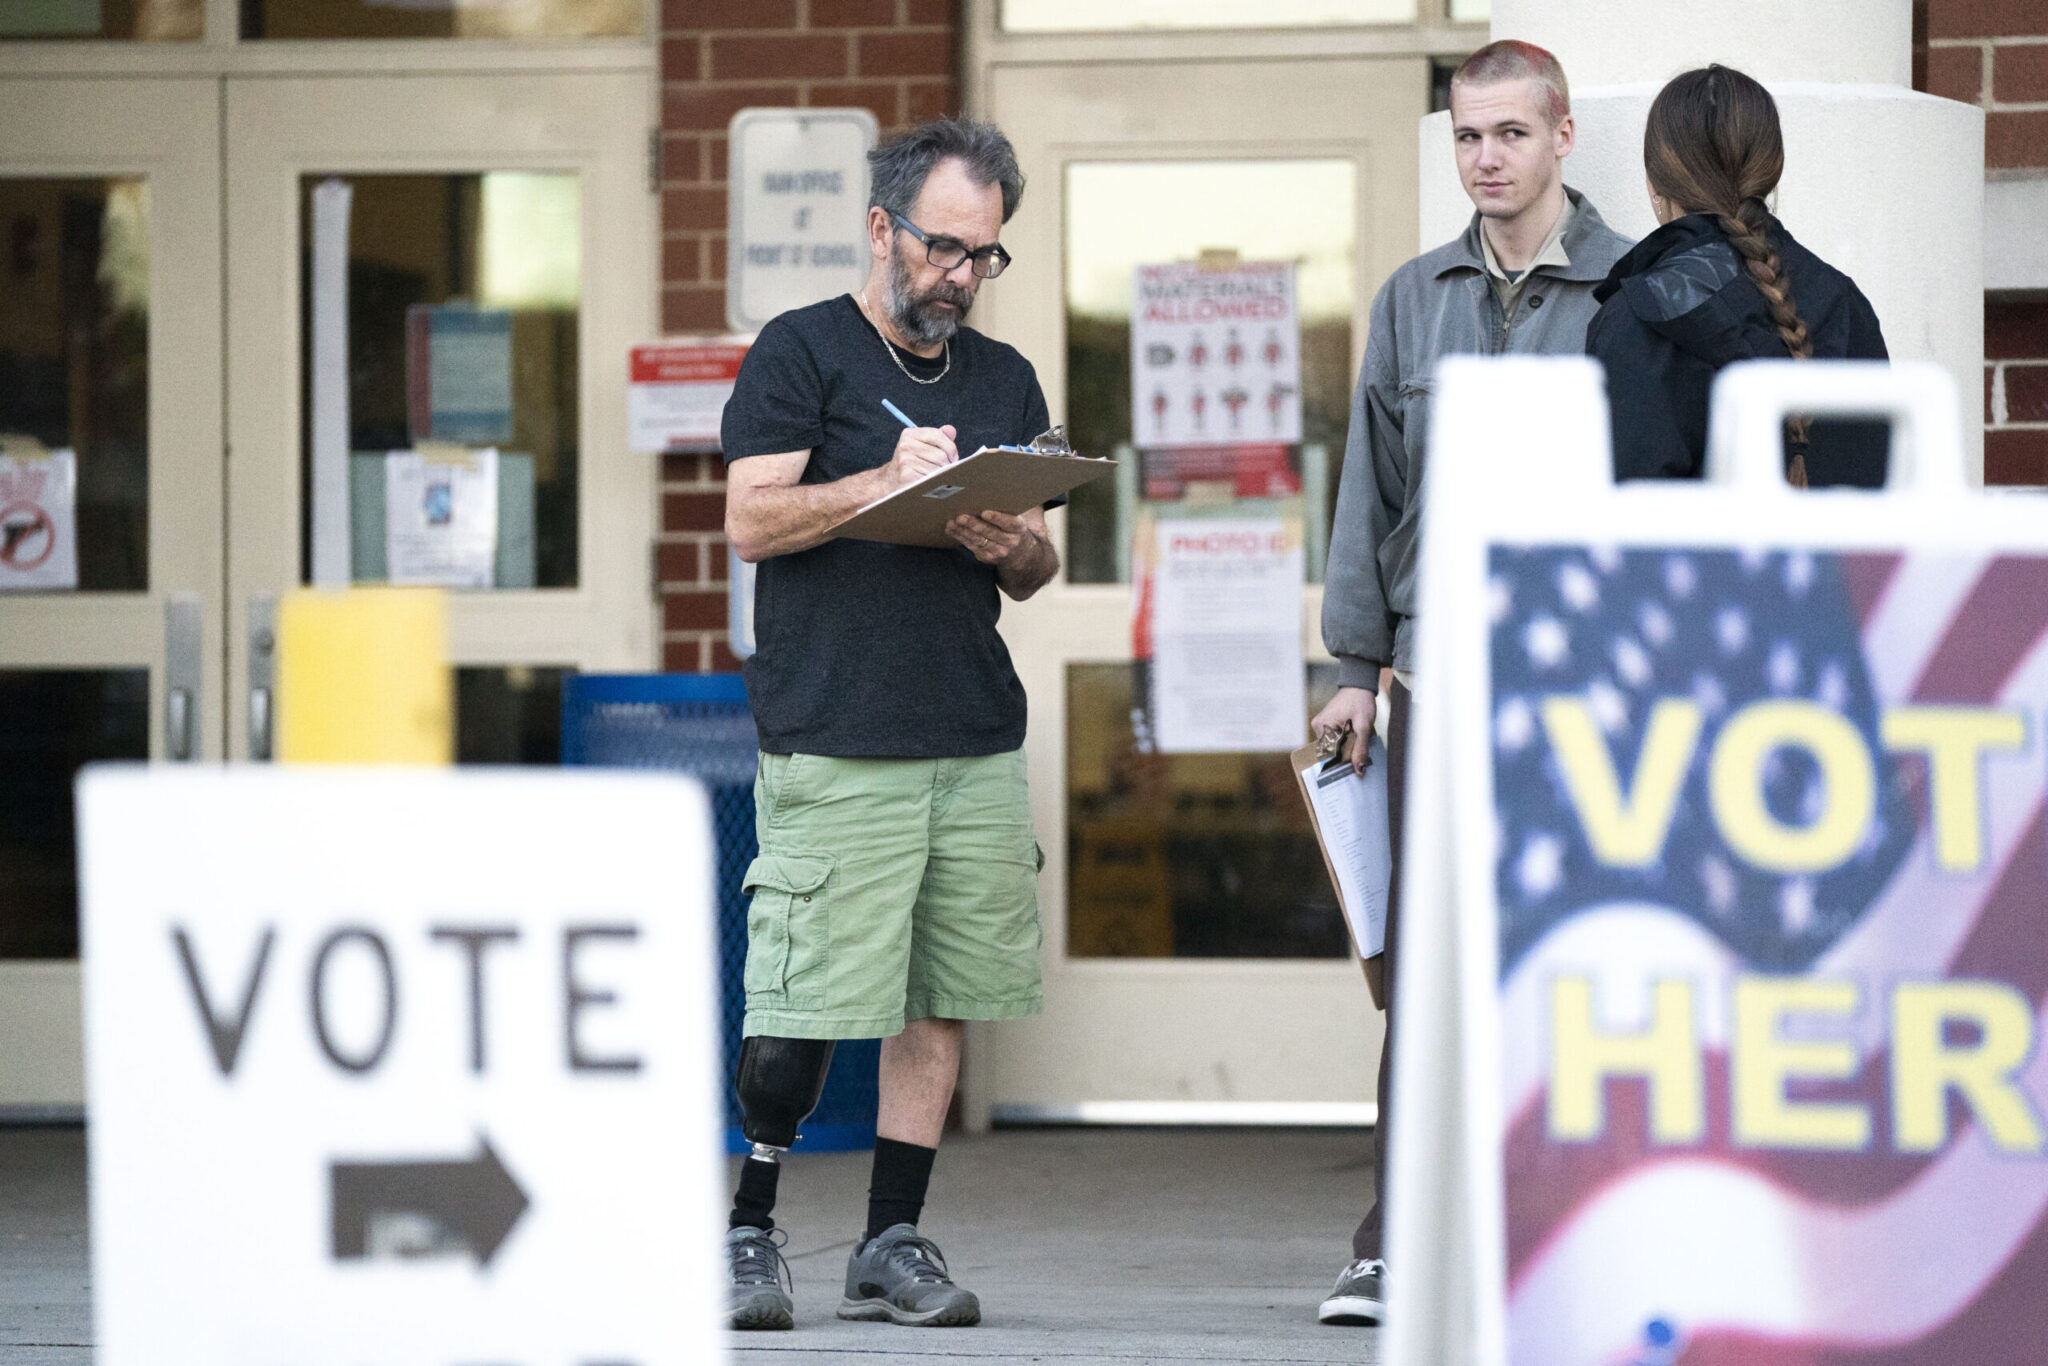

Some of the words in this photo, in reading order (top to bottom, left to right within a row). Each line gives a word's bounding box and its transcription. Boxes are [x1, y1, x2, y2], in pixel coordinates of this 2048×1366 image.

[1144, 297, 1289, 323] ALLOWED
[1170, 532, 1260, 554] PHOTO
[1540, 692, 2048, 874] VOT
[167, 920, 646, 1081] VOTE
